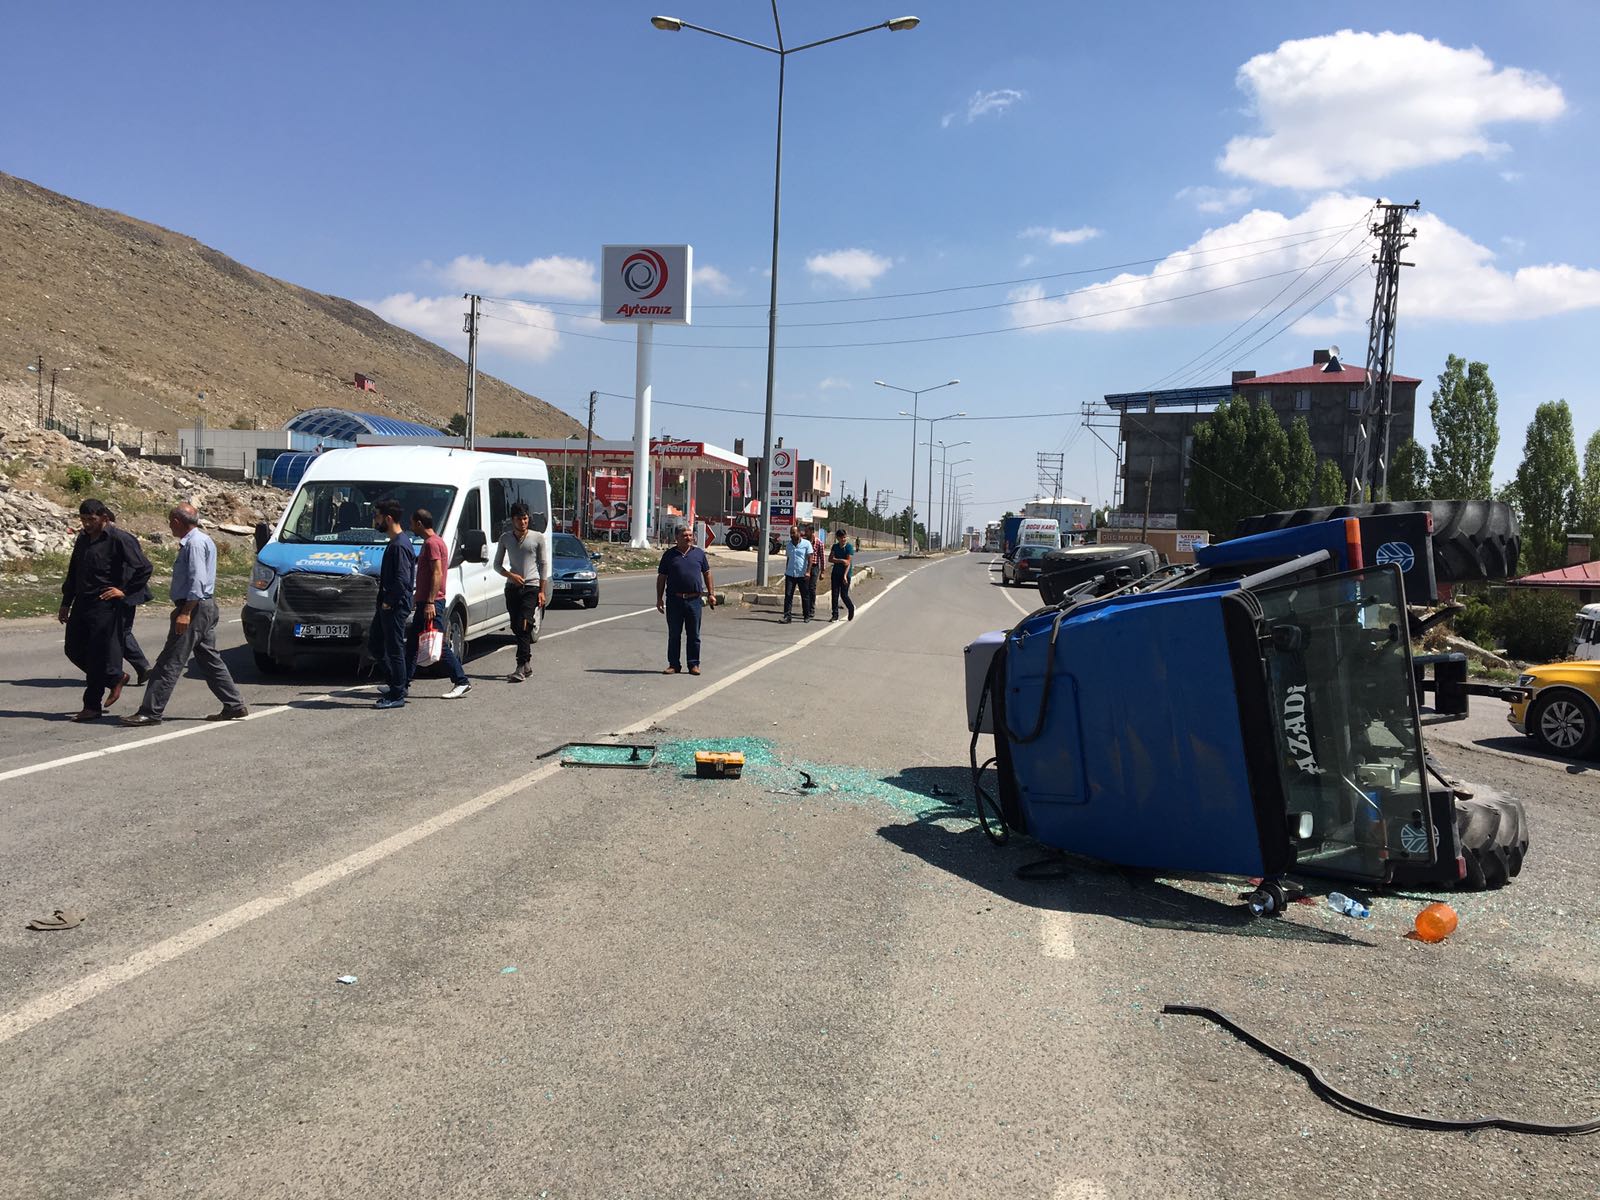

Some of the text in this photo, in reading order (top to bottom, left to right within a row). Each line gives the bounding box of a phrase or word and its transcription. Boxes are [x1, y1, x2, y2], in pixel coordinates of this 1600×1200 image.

[606, 303, 672, 317] Aytemiz
[651, 443, 697, 454] Aytemiz
[326, 625, 348, 635] 0312
